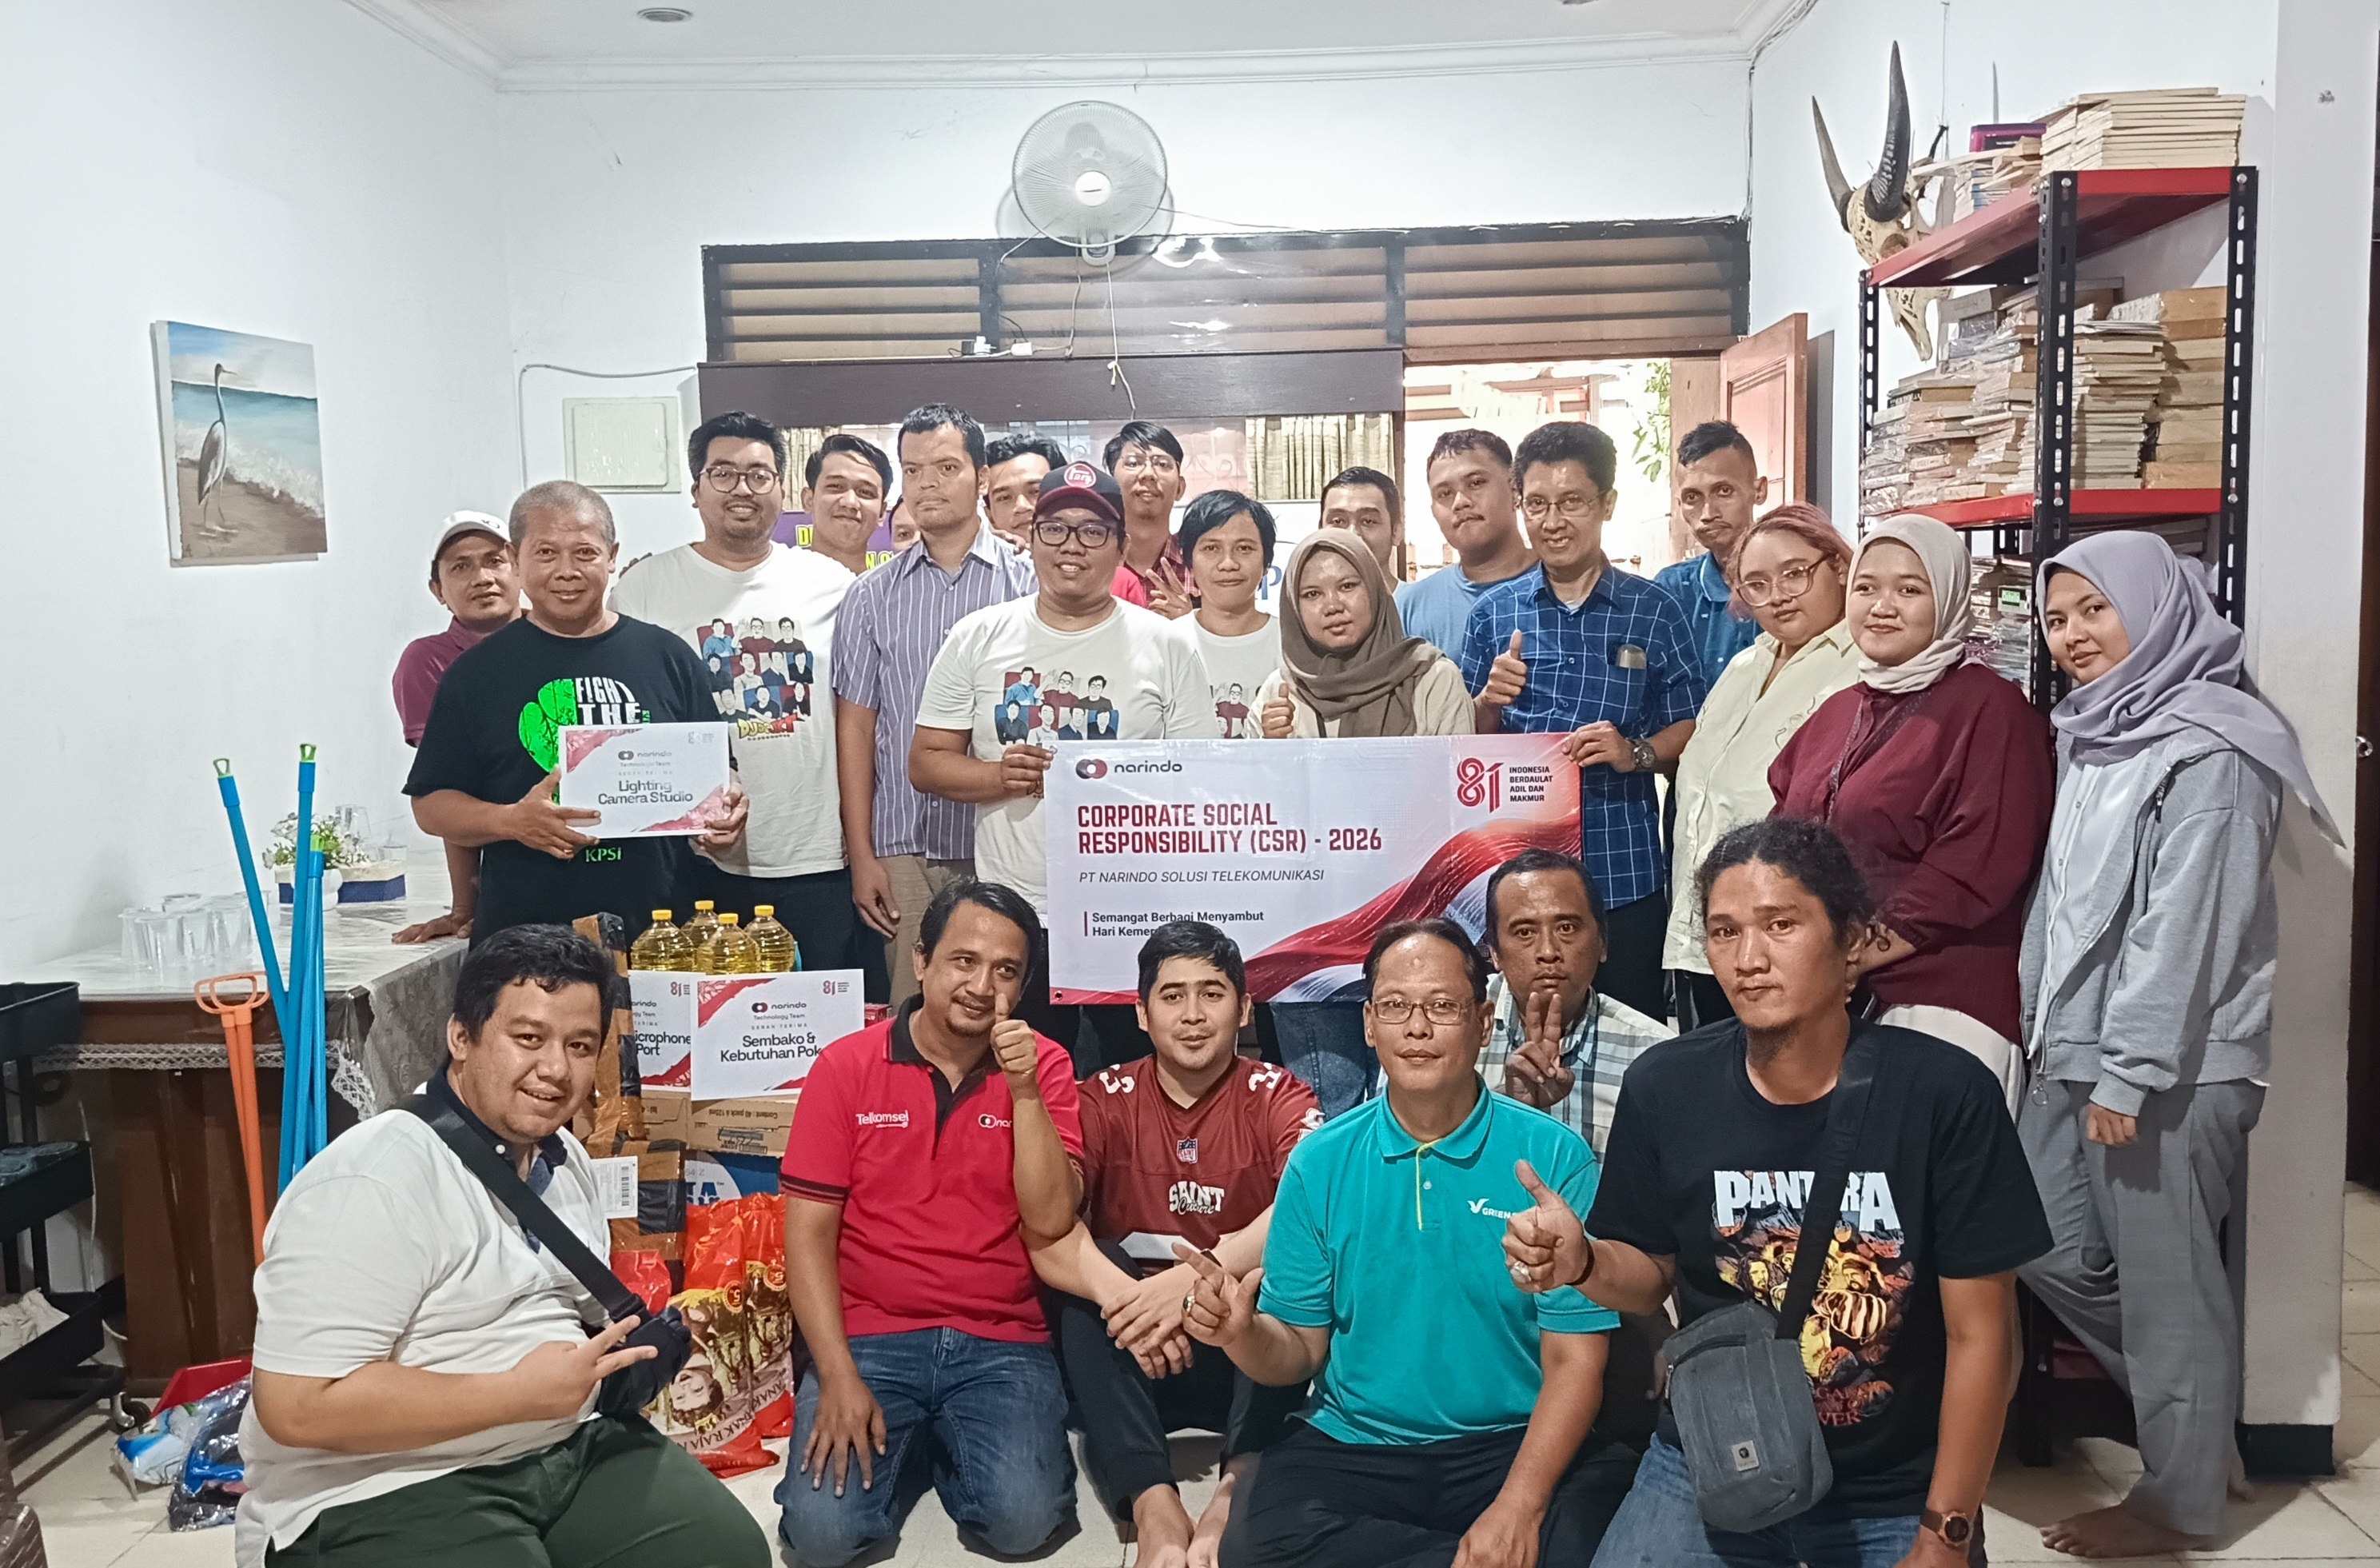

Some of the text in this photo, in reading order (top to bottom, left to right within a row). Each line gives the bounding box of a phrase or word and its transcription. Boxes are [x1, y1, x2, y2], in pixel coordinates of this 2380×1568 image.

[575, 676, 636, 704] FIGHT
[577, 703, 641, 725] THE
[1114, 760, 1183, 773] narindo
[1509, 765, 1550, 774] INDONESIA
[1457, 757, 1505, 813] 81
[1509, 775, 1553, 784] BERDAULAT
[619, 780, 672, 794] Lighting
[598, 791, 693, 805] Camera Studio
[1078, 803, 1278, 828] CORPORATE SOCIAL
[1078, 830, 1242, 854] RESPONSIBILITY
[1250, 828, 1306, 854] (CSR)
[1329, 828, 1382, 851] 2026
[1079, 869, 1324, 883] PT NARINDO SOLUSI TELEKOMUNIKASI
[1092, 911, 1264, 925] Semangat Berbagi Menyambut
[1092, 926, 1116, 936] Hari
[823, 980, 836, 995] 81
[771, 1001, 807, 1010] narindo
[635, 1030, 691, 1046] icrophone
[742, 1031, 816, 1047] Sembako &
[636, 1043, 660, 1055] Port
[720, 1047, 795, 1063] Kebutuhan
[731, 1108, 744, 1118] pack
[755, 1111, 779, 1119] Content
[855, 1110, 909, 1126] Telkomsel
[1169, 1180, 1225, 1212] SAINT
[690, 1430, 724, 1450] RAJA
